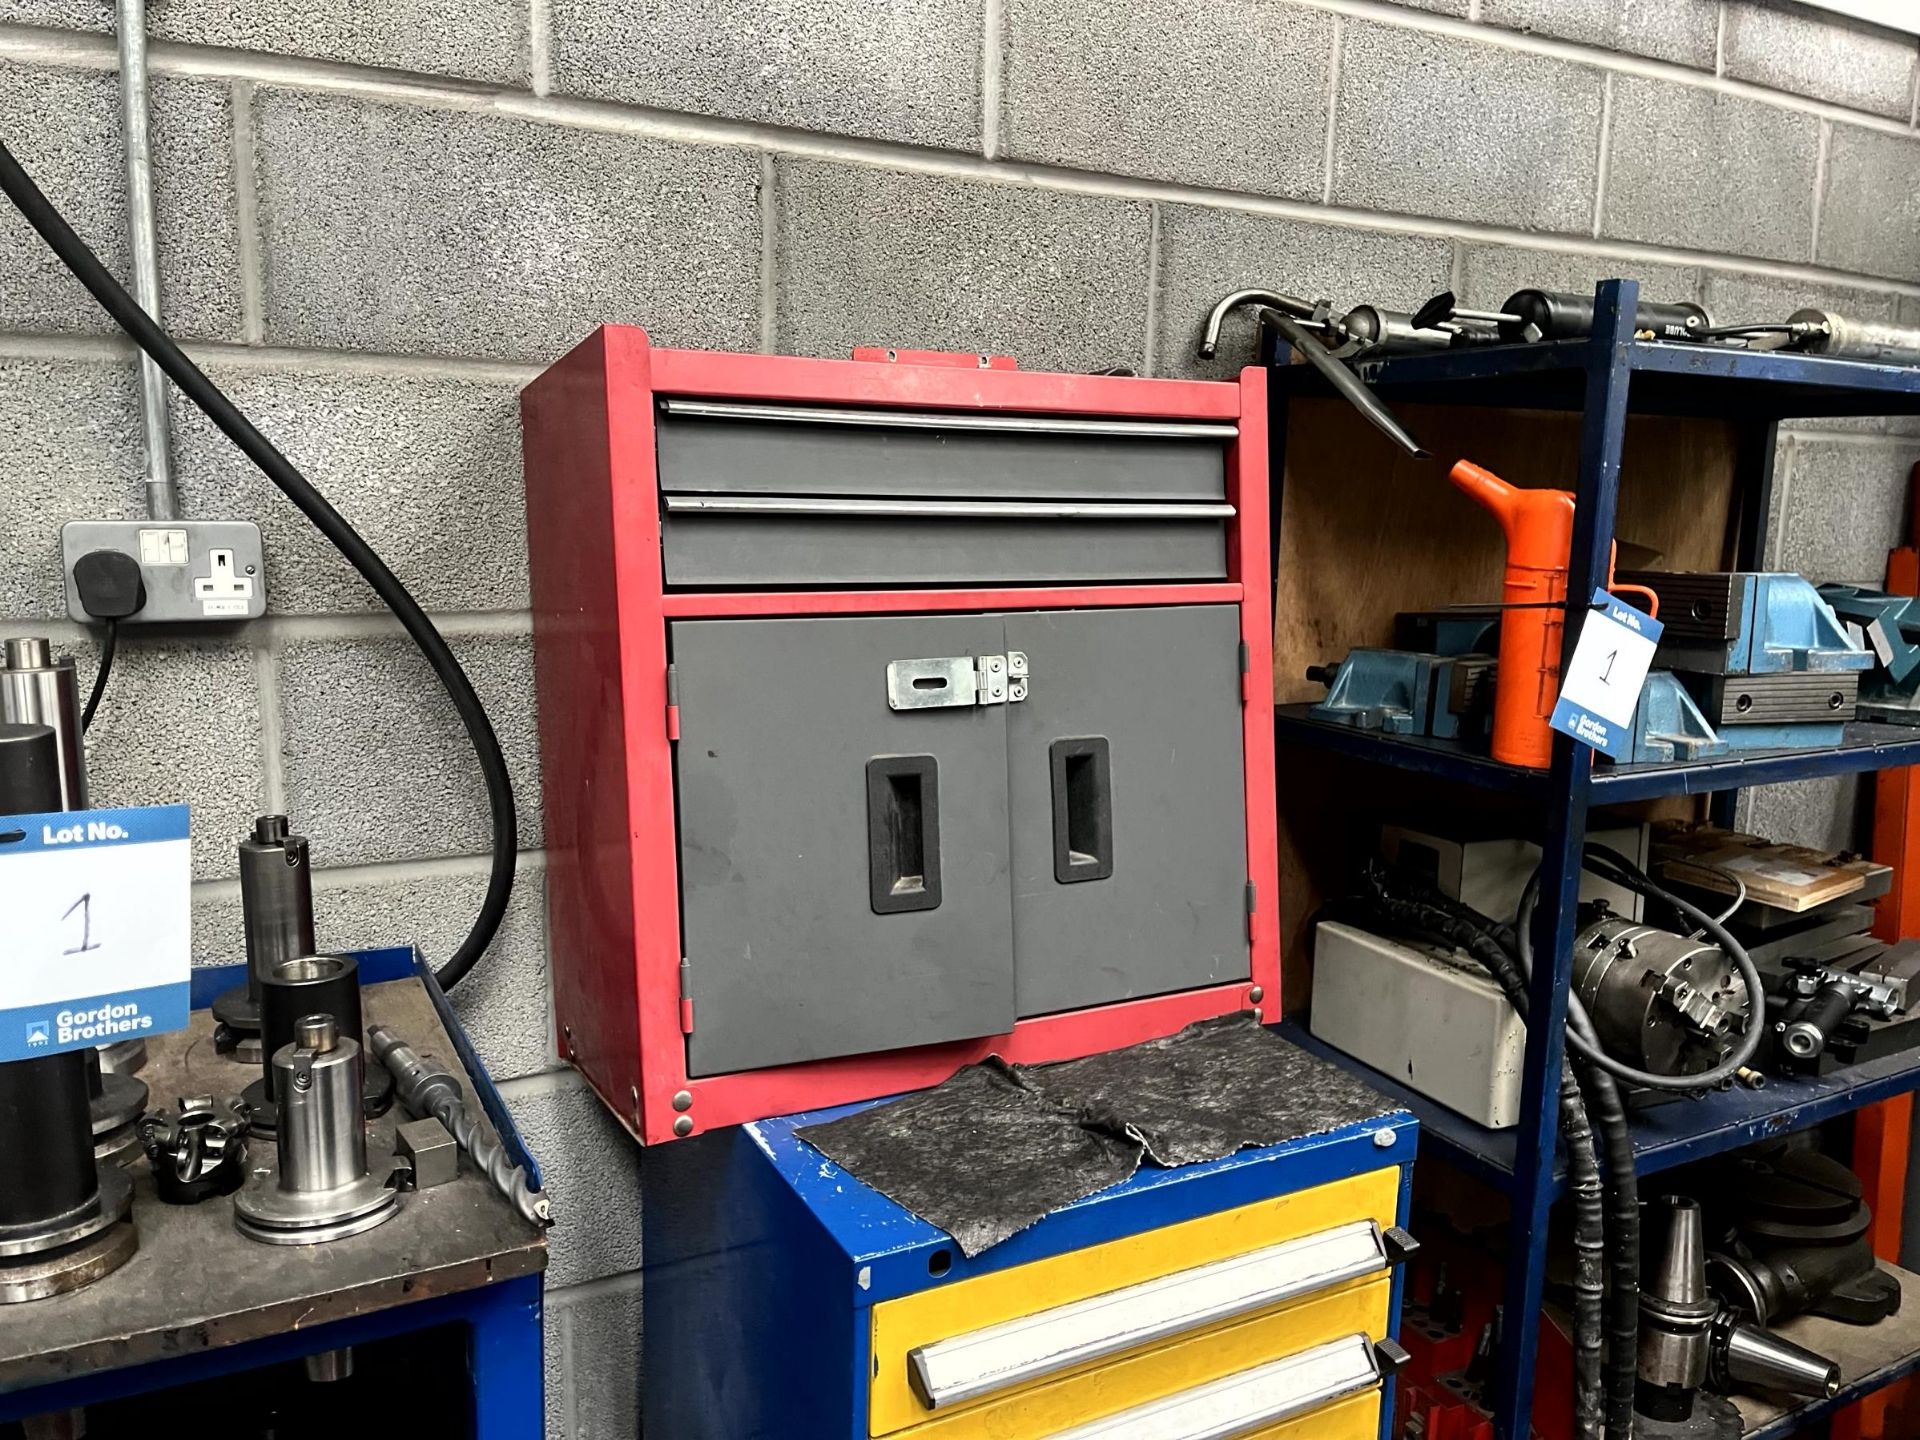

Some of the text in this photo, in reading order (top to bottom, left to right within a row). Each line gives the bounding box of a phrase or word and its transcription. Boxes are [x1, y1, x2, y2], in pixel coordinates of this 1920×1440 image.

[1612, 606, 1628, 623] Lot
[1599, 649, 1618, 686] 1
[1576, 726, 1608, 747] Brothers
[1579, 713, 1607, 736] Gordon
[42, 821, 129, 845] Lot No.
[61, 892, 102, 956] 1
[56, 1003, 138, 1028] Gordon
[57, 1015, 153, 1044] Brothers
